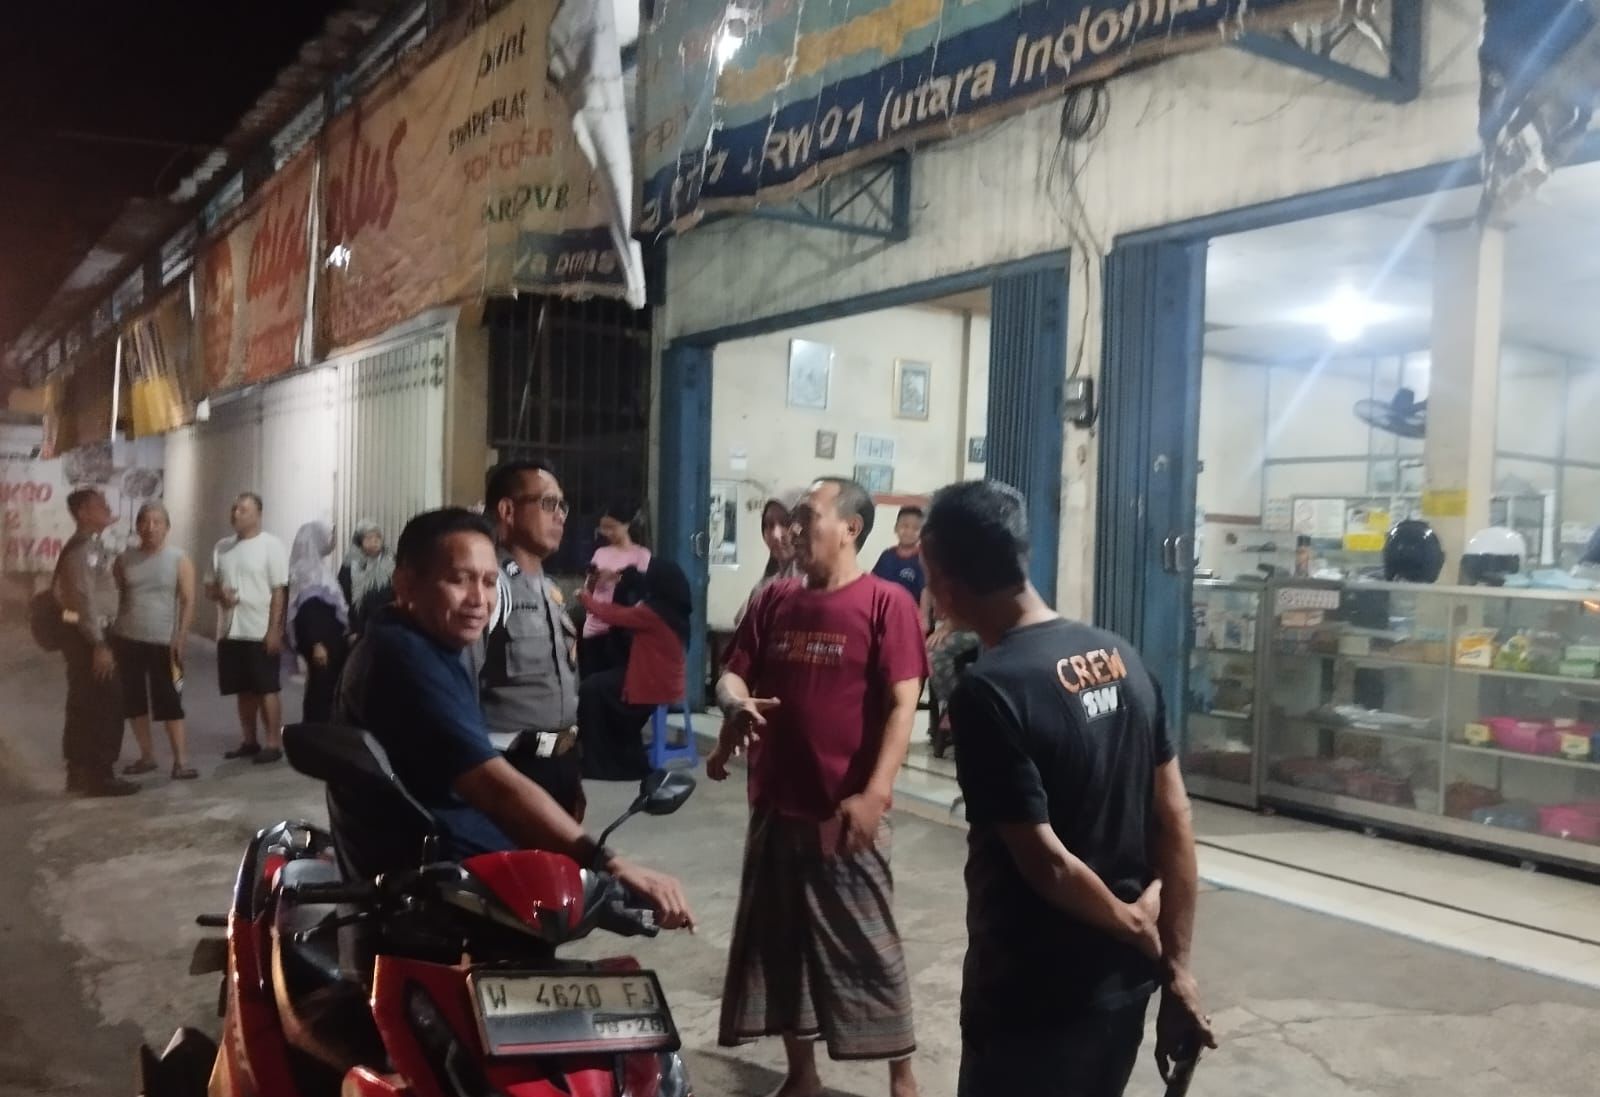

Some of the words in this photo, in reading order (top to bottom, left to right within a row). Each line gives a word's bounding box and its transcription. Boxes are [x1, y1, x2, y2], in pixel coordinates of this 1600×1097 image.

[820, 98, 865, 150] 01
[877, 60, 996, 140] (utara
[1056, 648, 1127, 693] CREW
[1082, 686, 1118, 717] SW
[487, 983, 507, 1010] W
[535, 983, 602, 1009] 4620
